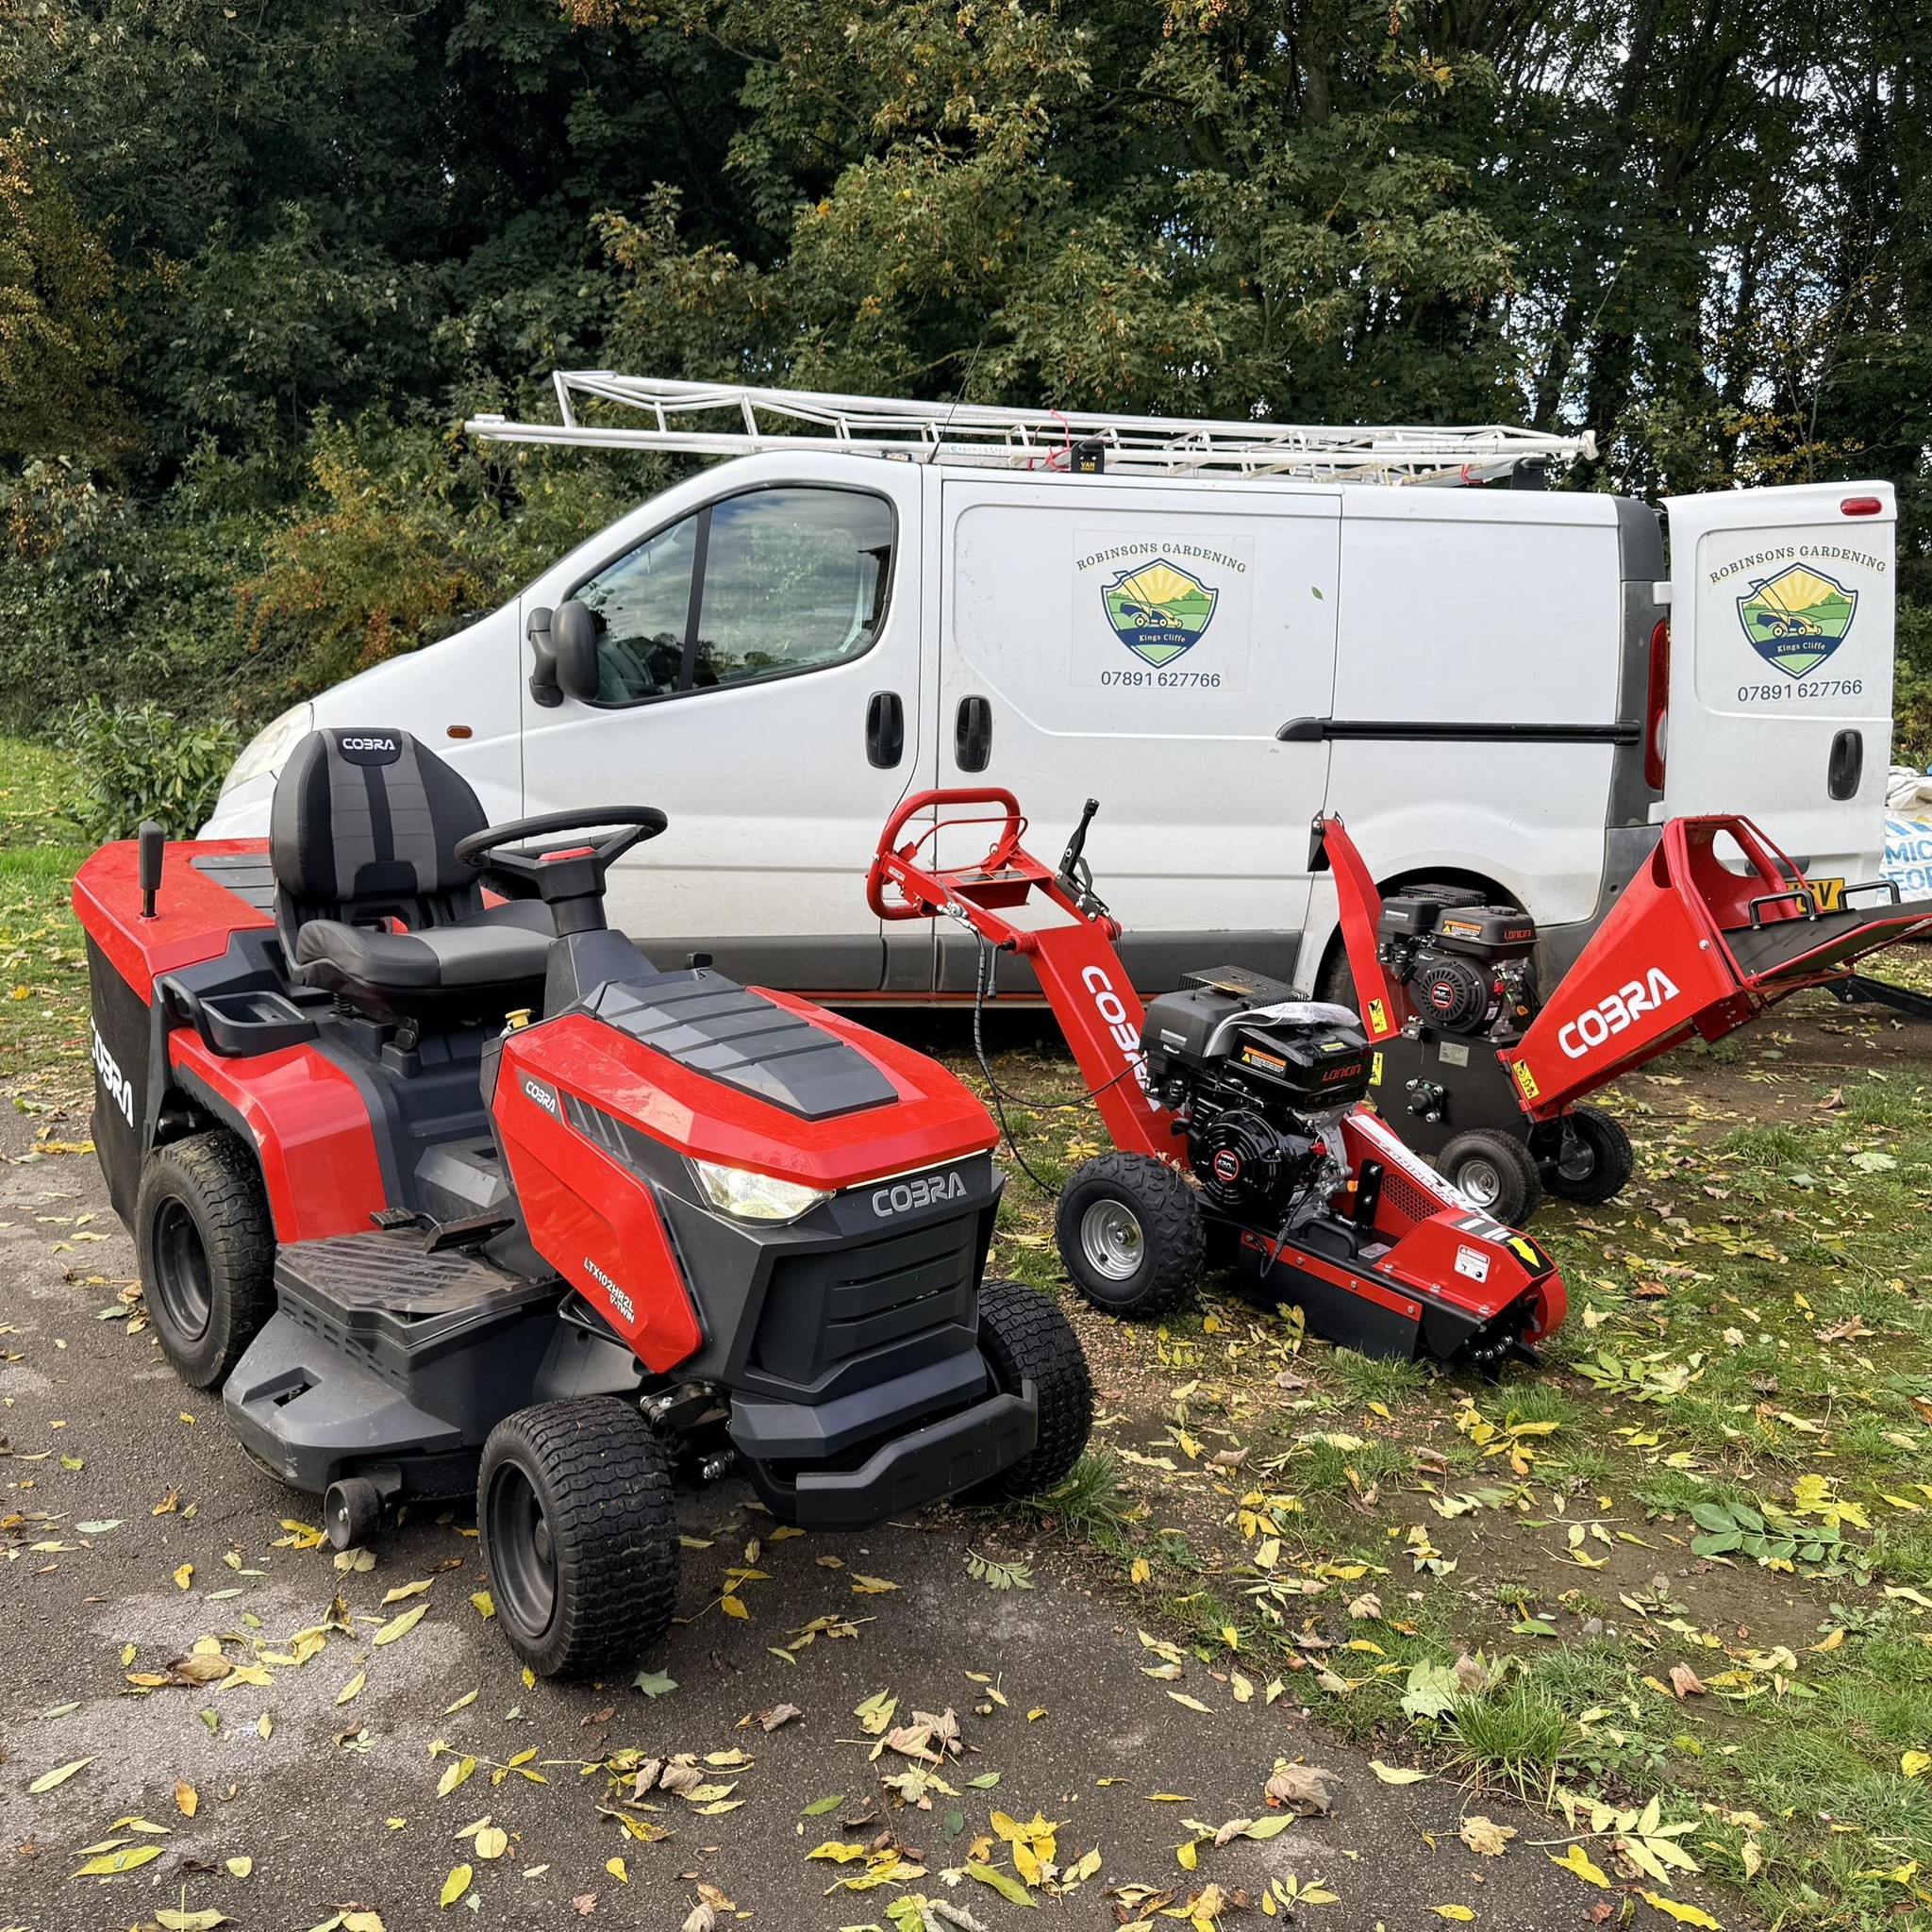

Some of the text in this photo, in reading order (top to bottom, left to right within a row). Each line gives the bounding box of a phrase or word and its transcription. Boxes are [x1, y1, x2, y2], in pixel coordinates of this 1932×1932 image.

[1076, 542, 1246, 574] ROBINSONS GARDENING
[1709, 546, 1886, 584] ROBINSONS GARDENING
[1139, 633, 1186, 642] Kings Cliffe
[1777, 641, 1825, 653] Kings Cliffe
[1101, 671, 1221, 688] 07891 627766
[1738, 679, 1862, 702] 07891 627766
[342, 738, 396, 750] COBRA
[1504, 929, 1532, 940] LONCIN
[1558, 967, 1680, 1059] COBRA
[91, 1015, 134, 1128] OBRA
[1322, 1063, 1361, 1082] LONCIN
[525, 1080, 556, 1113] COBRA
[872, 1172, 968, 1218] COBRA
[584, 1257, 634, 1313] LTX102HR2L
[609, 1293, 635, 1324] V-TWIN
